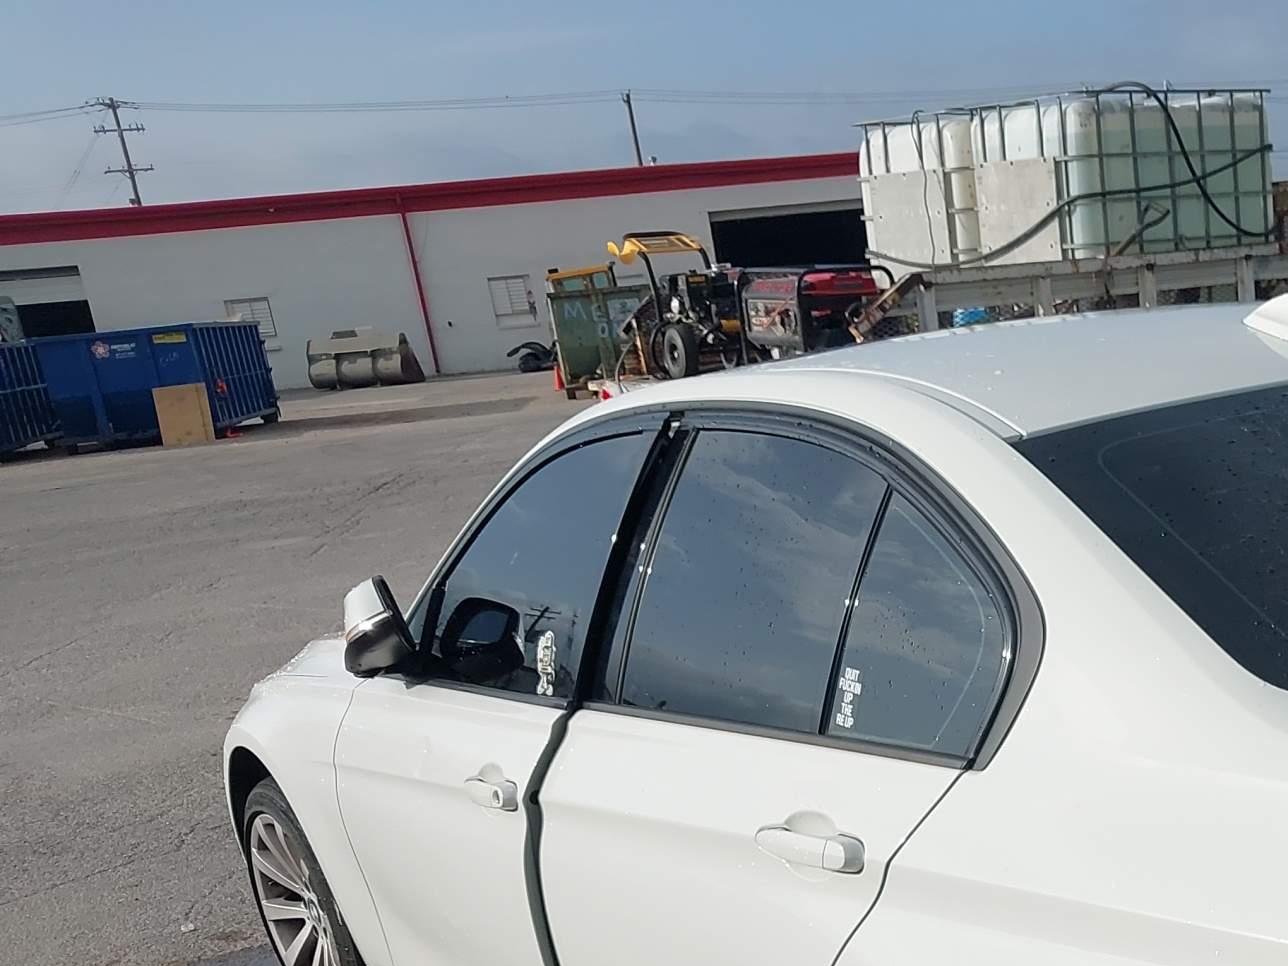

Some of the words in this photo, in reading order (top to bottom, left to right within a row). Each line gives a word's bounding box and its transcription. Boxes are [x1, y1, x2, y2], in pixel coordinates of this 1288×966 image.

[845, 667, 860, 681] QUIT
[839, 677, 861, 695] FUCKIN
[844, 691, 854, 703] UP
[841, 702, 853, 716] THE
[844, 716, 854, 728] UP
